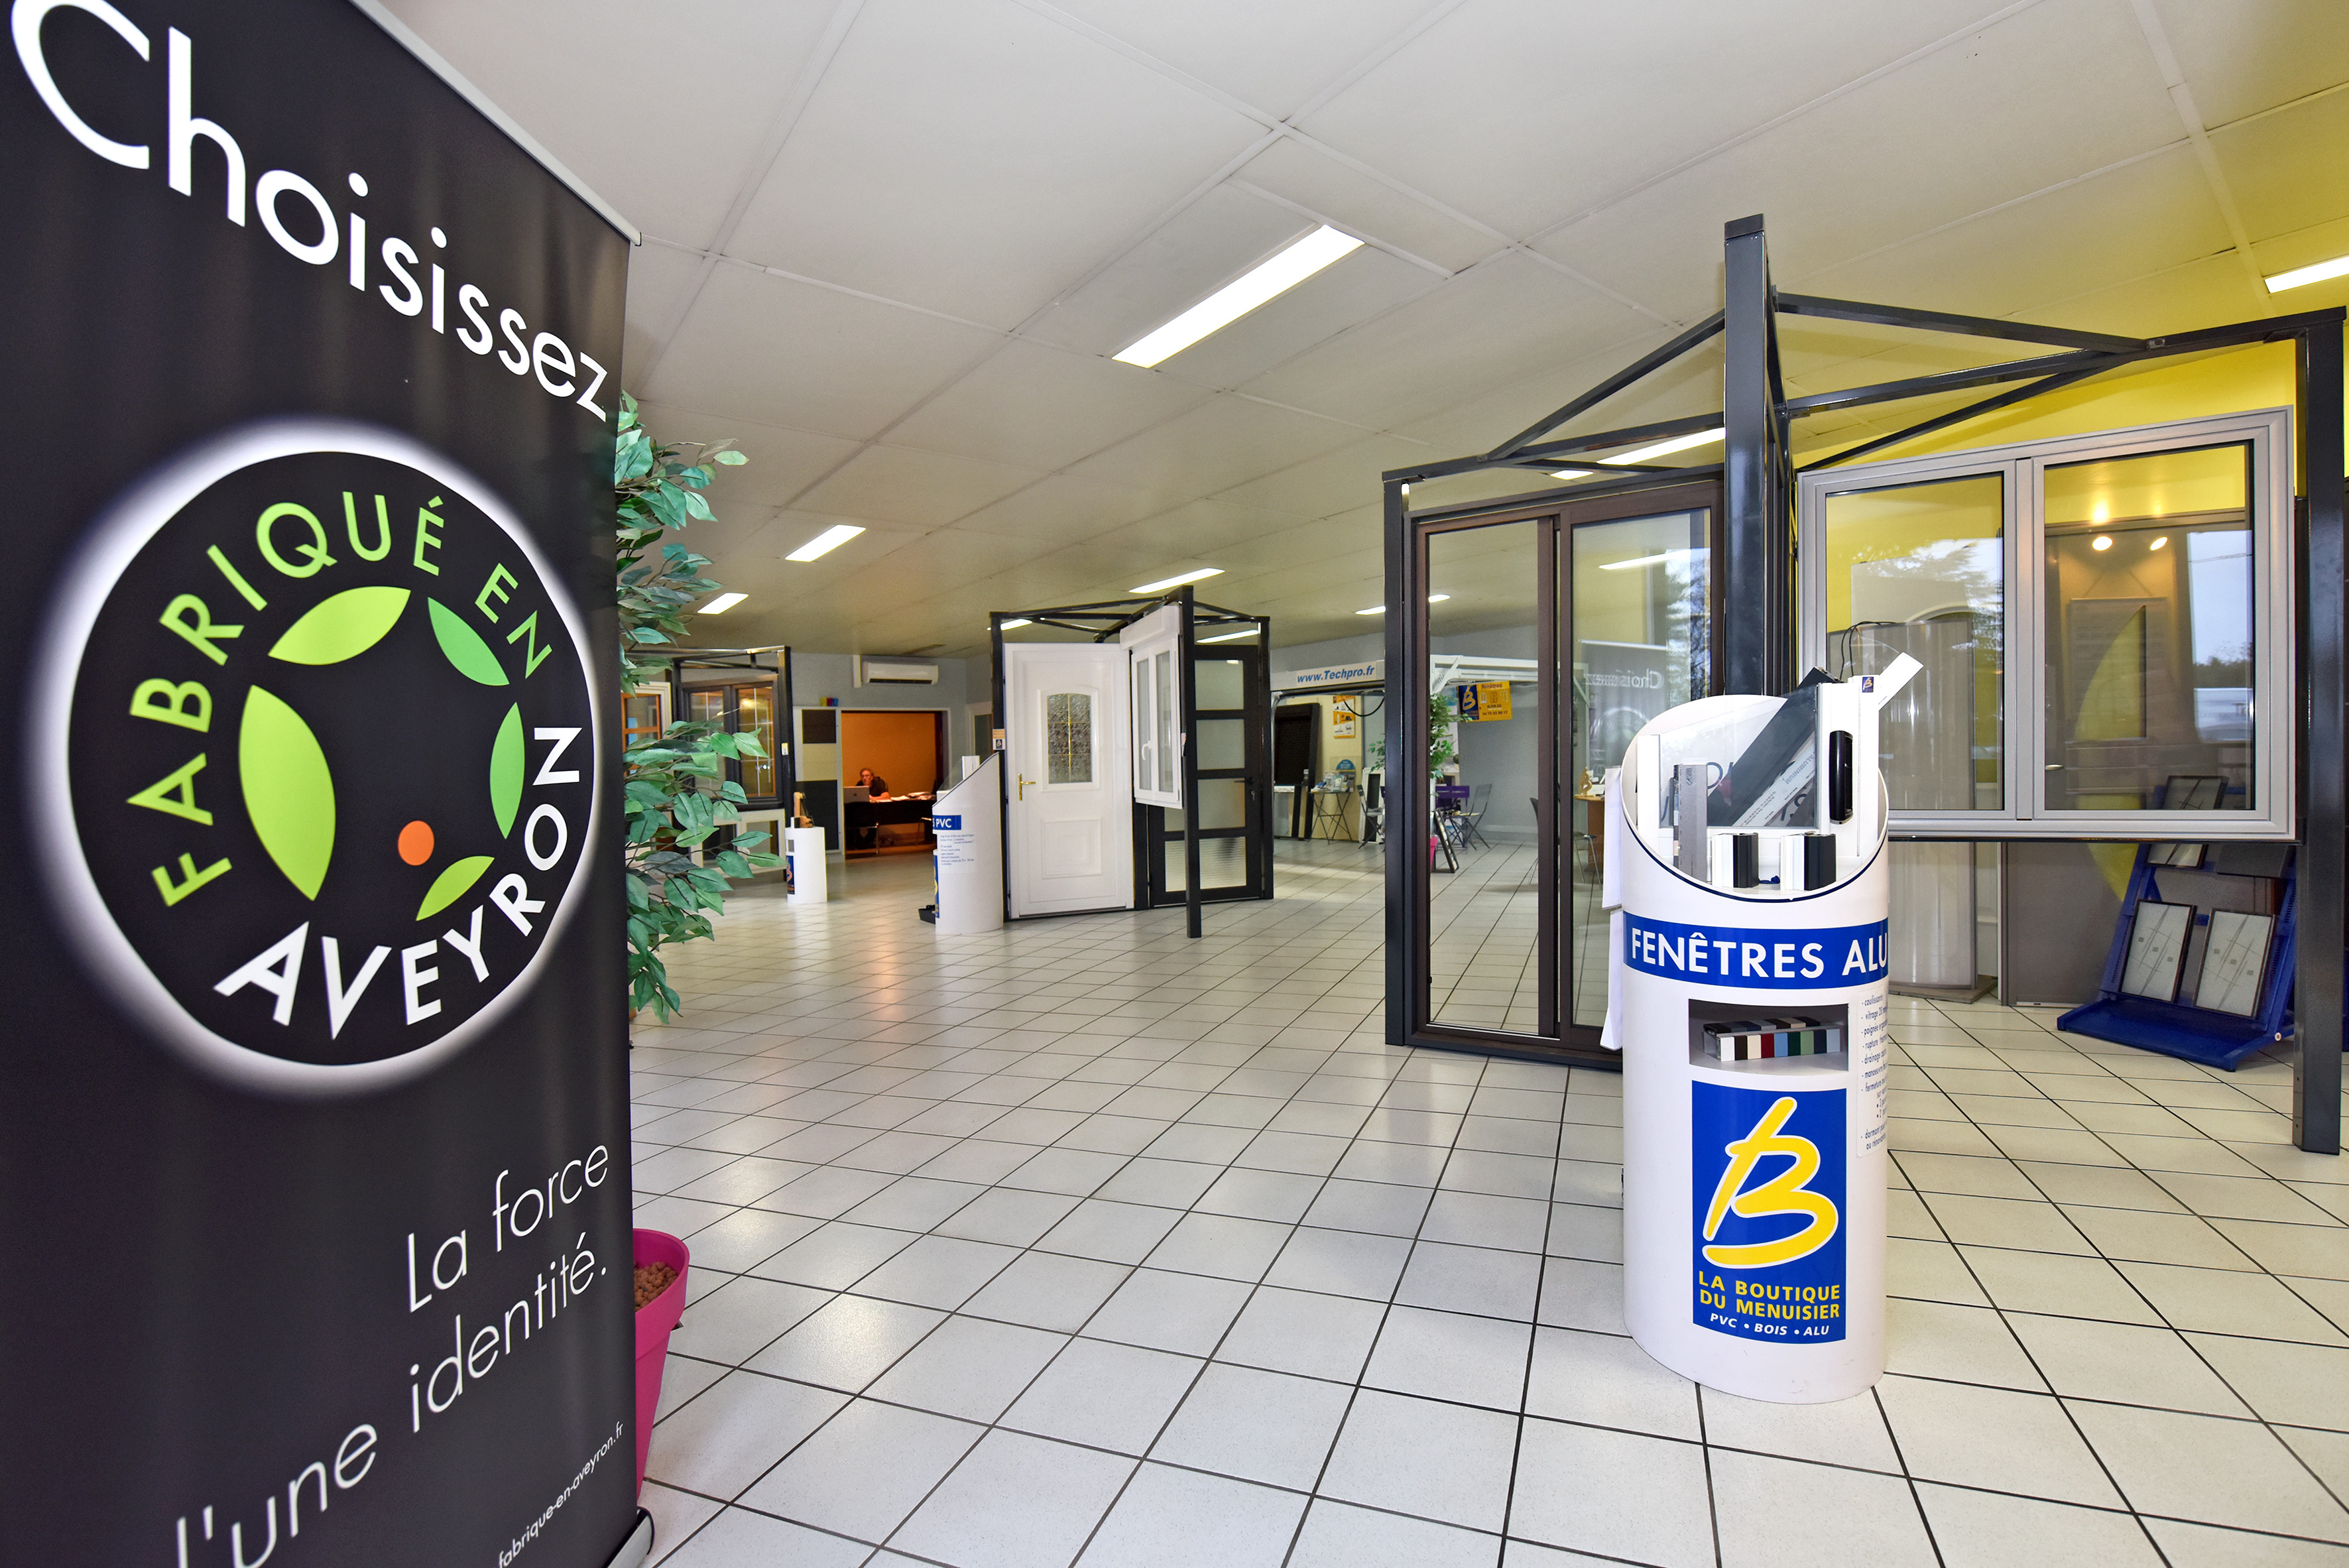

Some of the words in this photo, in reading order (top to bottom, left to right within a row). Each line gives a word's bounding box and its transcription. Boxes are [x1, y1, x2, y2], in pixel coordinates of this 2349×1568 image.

[11, 0, 608, 422] Choisissez
[126, 491, 446, 907] FABRIQUÉ
[475, 562, 552, 679] EN
[1297, 665, 1375, 683] www.Techpro.fr
[935, 818, 952, 828] PVC
[213, 726, 582, 1040] AVEYRON
[1631, 927, 1825, 979] FENÊTRES
[1841, 932, 1888, 976] ALU
[408, 1229, 467, 1313] La
[492, 1144, 609, 1253] force
[1699, 1270, 1726, 1292] LA
[1735, 1280, 1840, 1304] BOUTIQUE
[1700, 1289, 1726, 1309] DU
[1736, 1299, 1840, 1321] MENUISIER
[410, 1231, 607, 1433] identité.
[1710, 1313, 1738, 1328] PVC
[1754, 1323, 1788, 1336] BOIS
[1803, 1325, 1830, 1336] ALU
